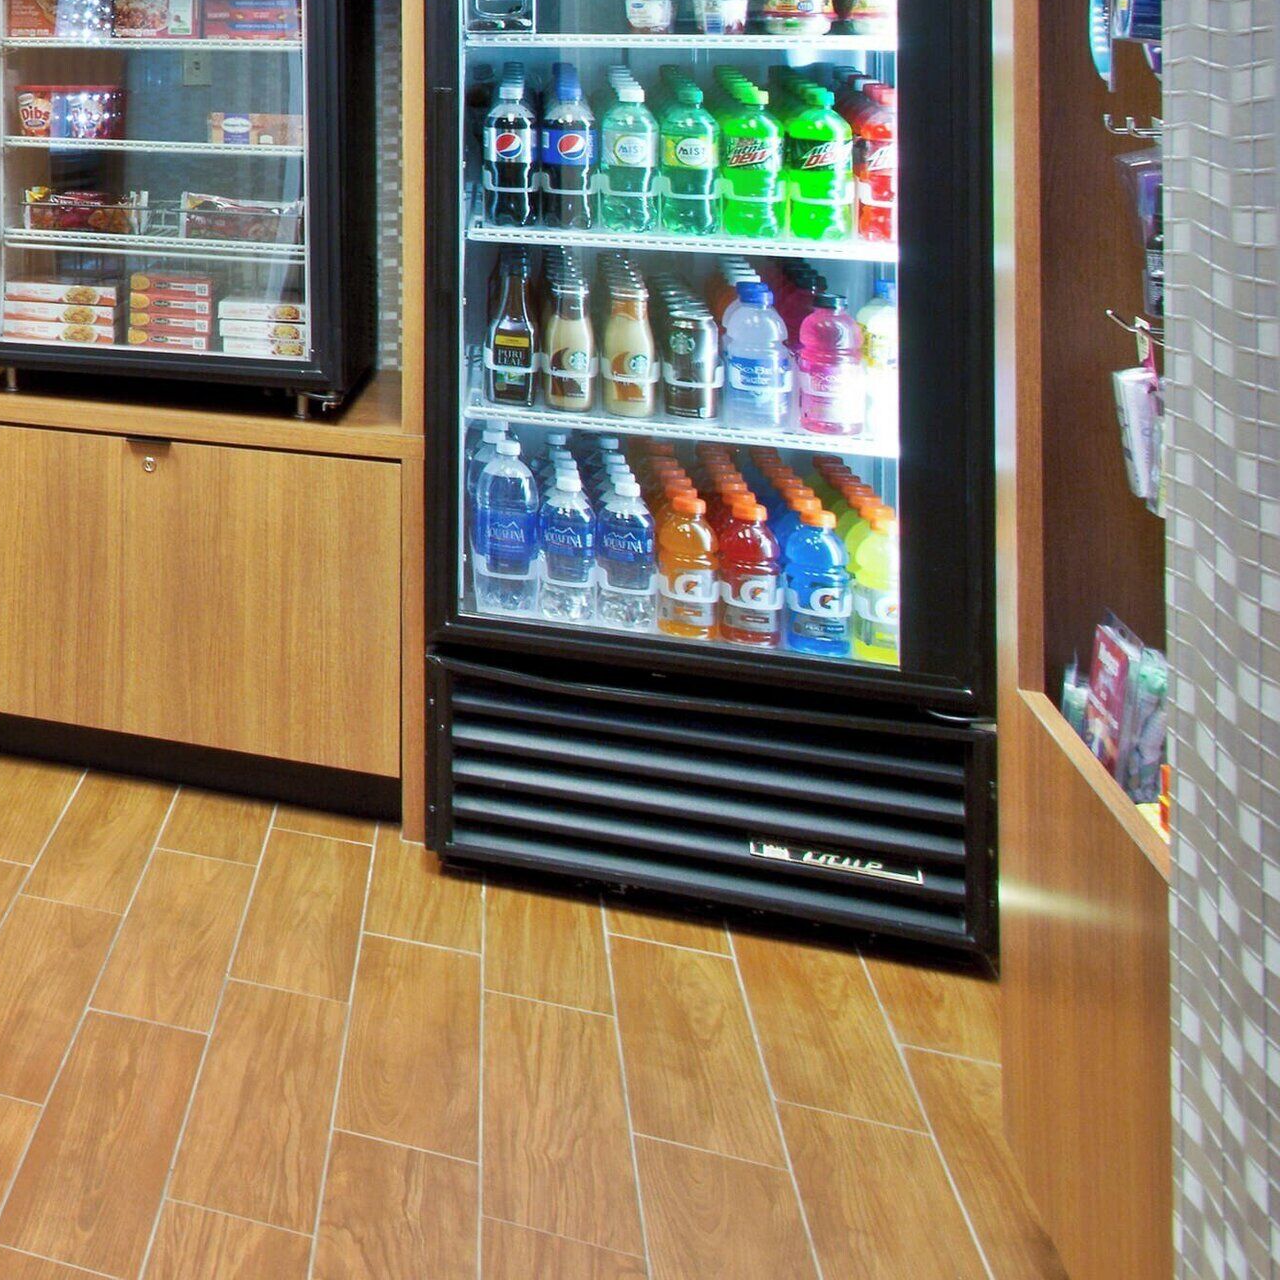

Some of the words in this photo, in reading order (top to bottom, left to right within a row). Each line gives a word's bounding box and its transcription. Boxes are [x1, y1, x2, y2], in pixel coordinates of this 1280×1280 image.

[20, 105, 51, 121] Dibs
[485, 527, 526, 544] AQUAFINA
[544, 530, 583, 549] AQUAFINA
[603, 535, 644, 554] AQUAFINA
